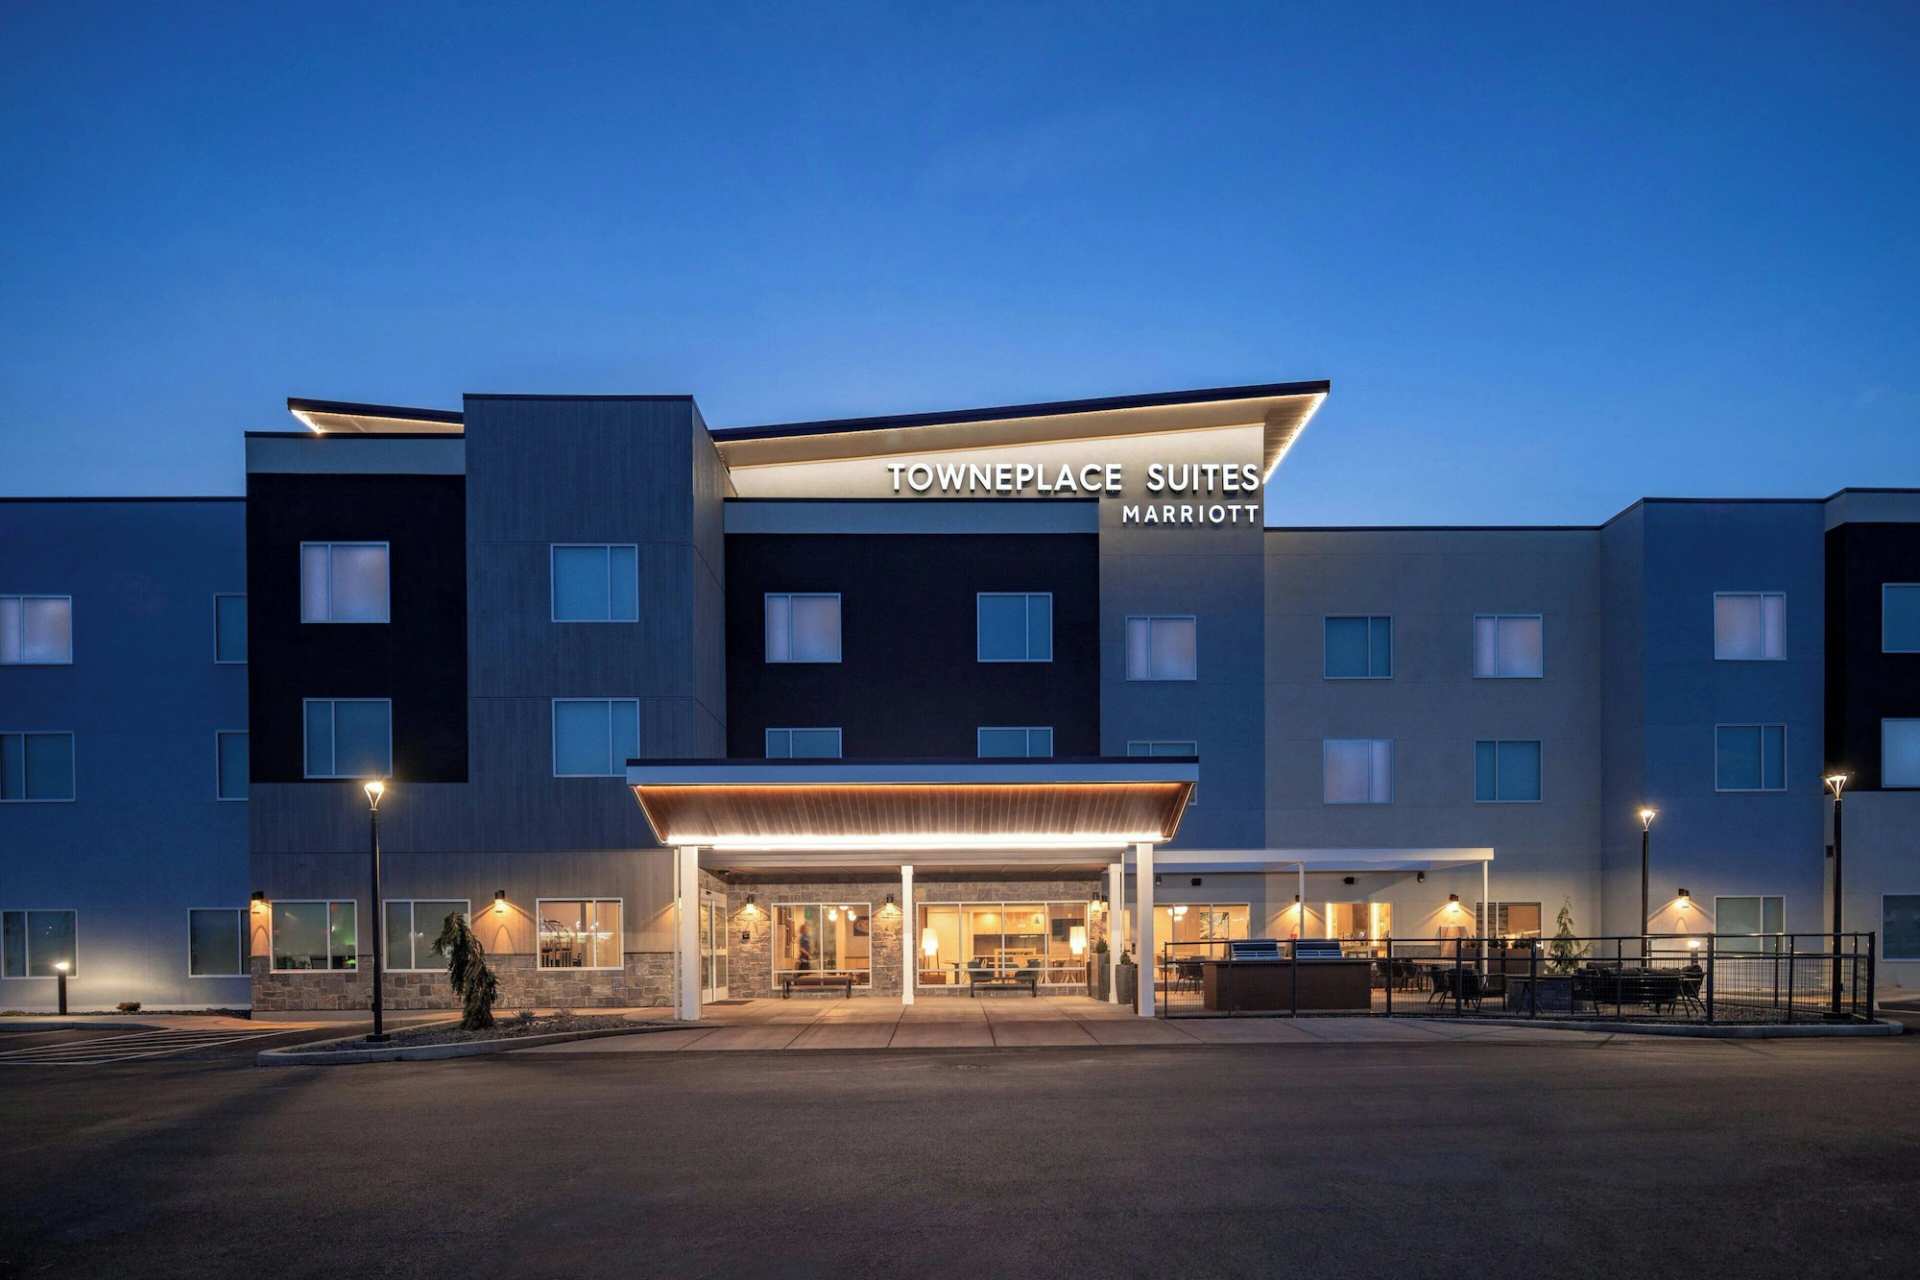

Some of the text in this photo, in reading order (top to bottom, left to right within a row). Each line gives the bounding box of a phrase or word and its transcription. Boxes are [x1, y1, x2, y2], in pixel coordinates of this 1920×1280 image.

[888, 463, 1261, 492] TOWNEPLACE SUITES
[1122, 503, 1260, 524] MARRIOTT
